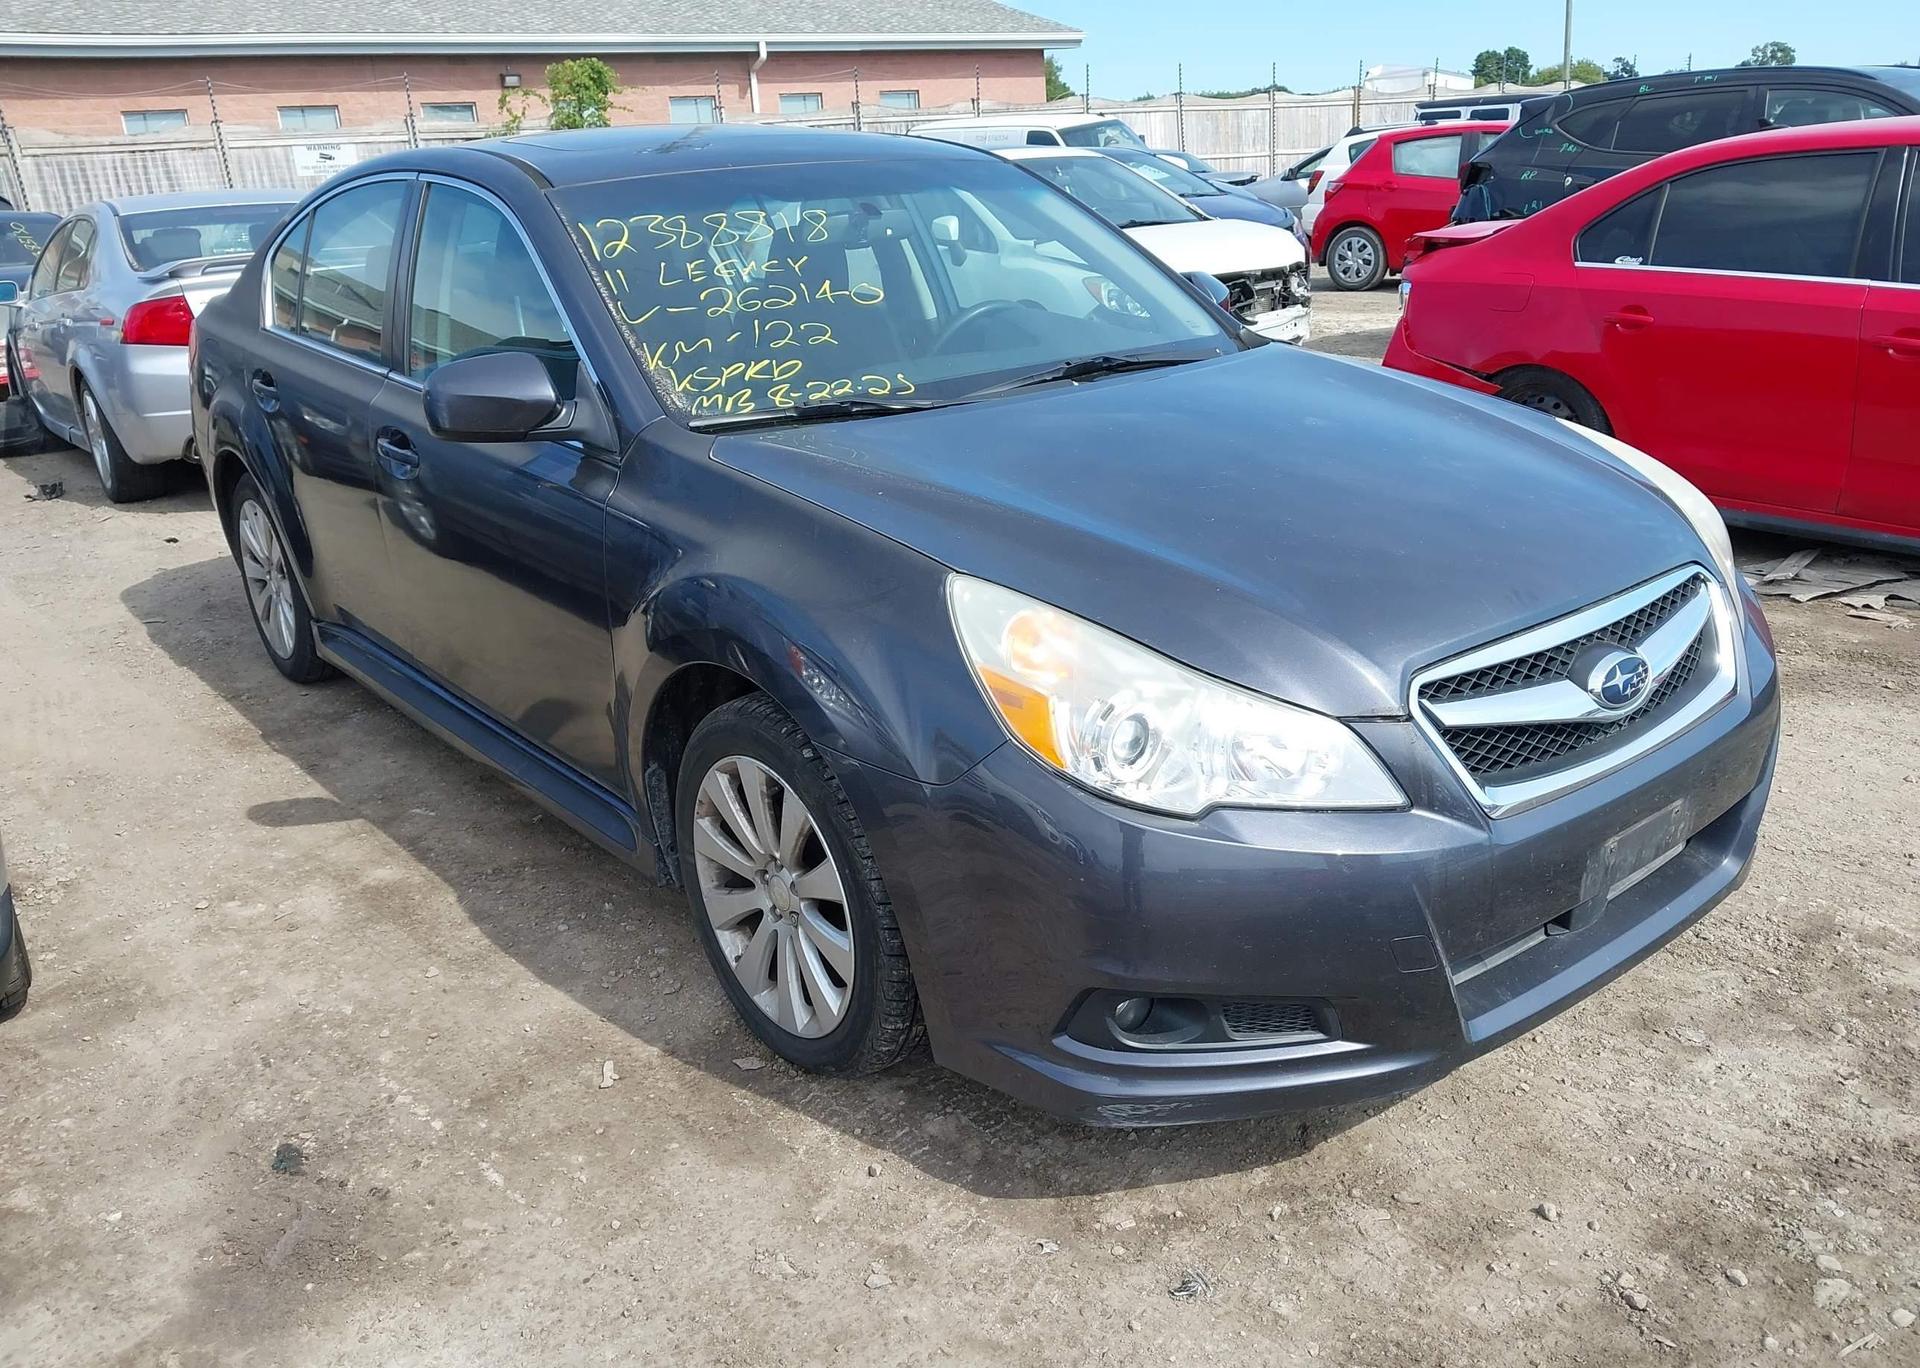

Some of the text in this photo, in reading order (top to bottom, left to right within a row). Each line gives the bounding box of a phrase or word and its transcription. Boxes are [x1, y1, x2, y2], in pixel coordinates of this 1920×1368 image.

[578, 209, 828, 261] 12388818
[604, 255, 808, 295] 11 LEGACY
[692, 388, 756, 416] MB
